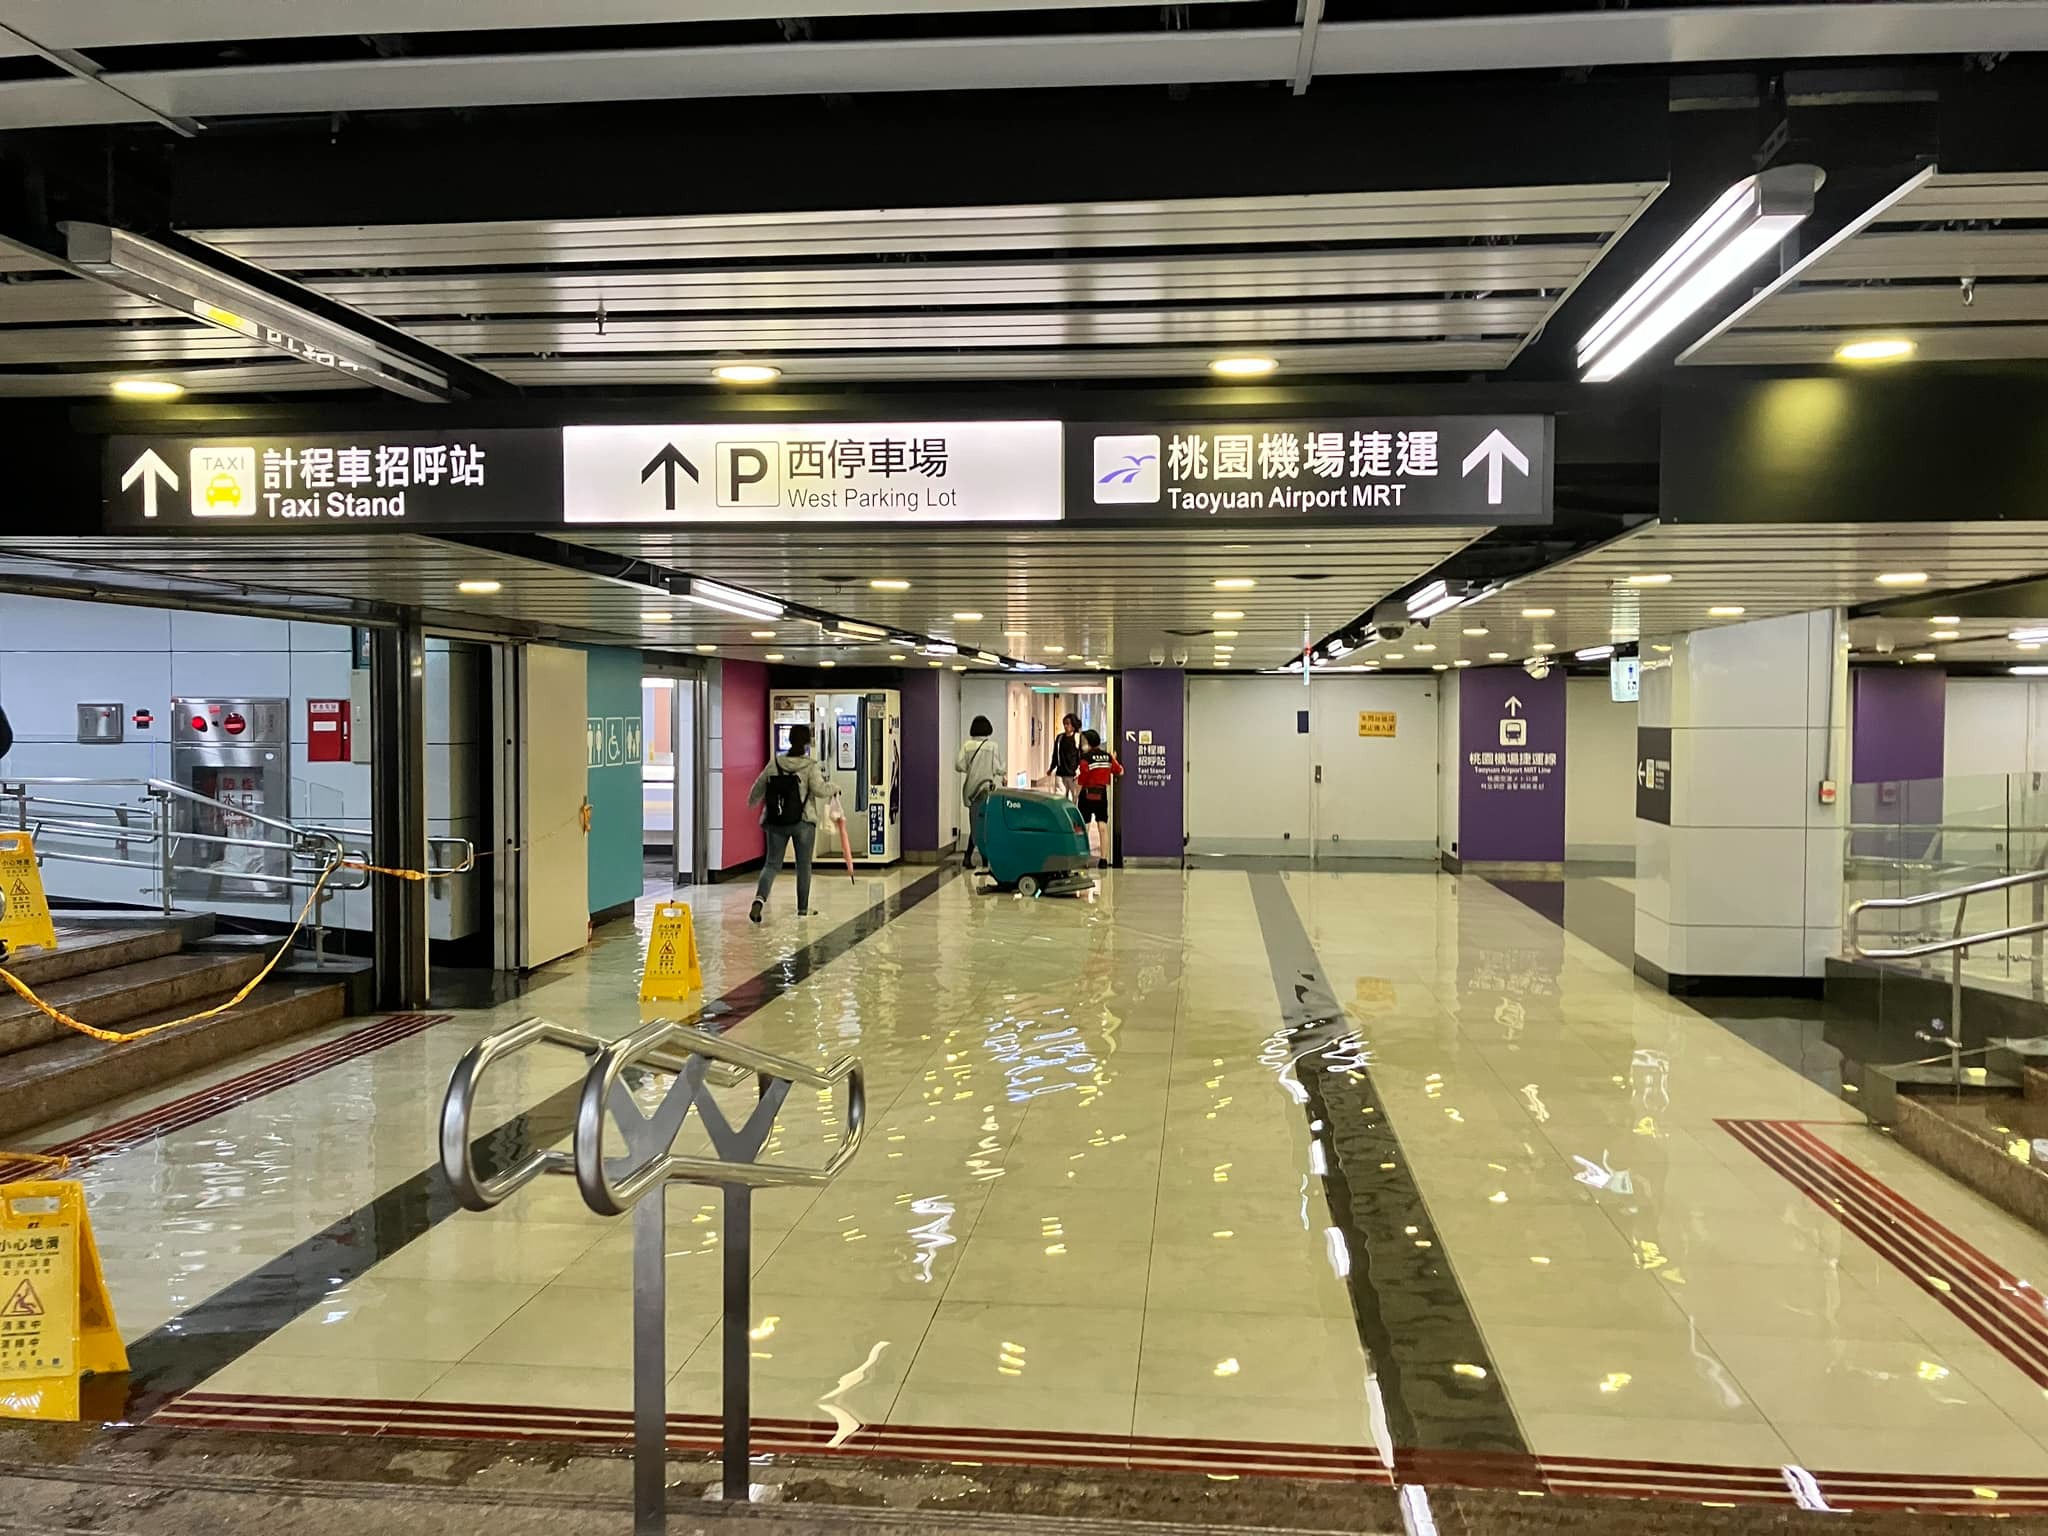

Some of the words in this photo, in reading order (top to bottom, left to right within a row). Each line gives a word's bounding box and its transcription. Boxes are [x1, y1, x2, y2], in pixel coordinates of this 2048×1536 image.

[202, 456, 244, 471] TAXI
[262, 444, 486, 490] 計程車招呼站
[786, 438, 949, 480] 西停車場
[1167, 431, 1439, 481] 桃園機場捷運
[730, 448, 768, 502] P
[263, 491, 320, 518] Taxi
[326, 491, 405, 518] Stand
[787, 488, 839, 508] West
[845, 487, 919, 512] Parking
[926, 487, 957, 507] Lot
[1167, 486, 1264, 514] Taoyuan
[1268, 485, 1347, 513] Airport
[1352, 484, 1406, 507] MRT
